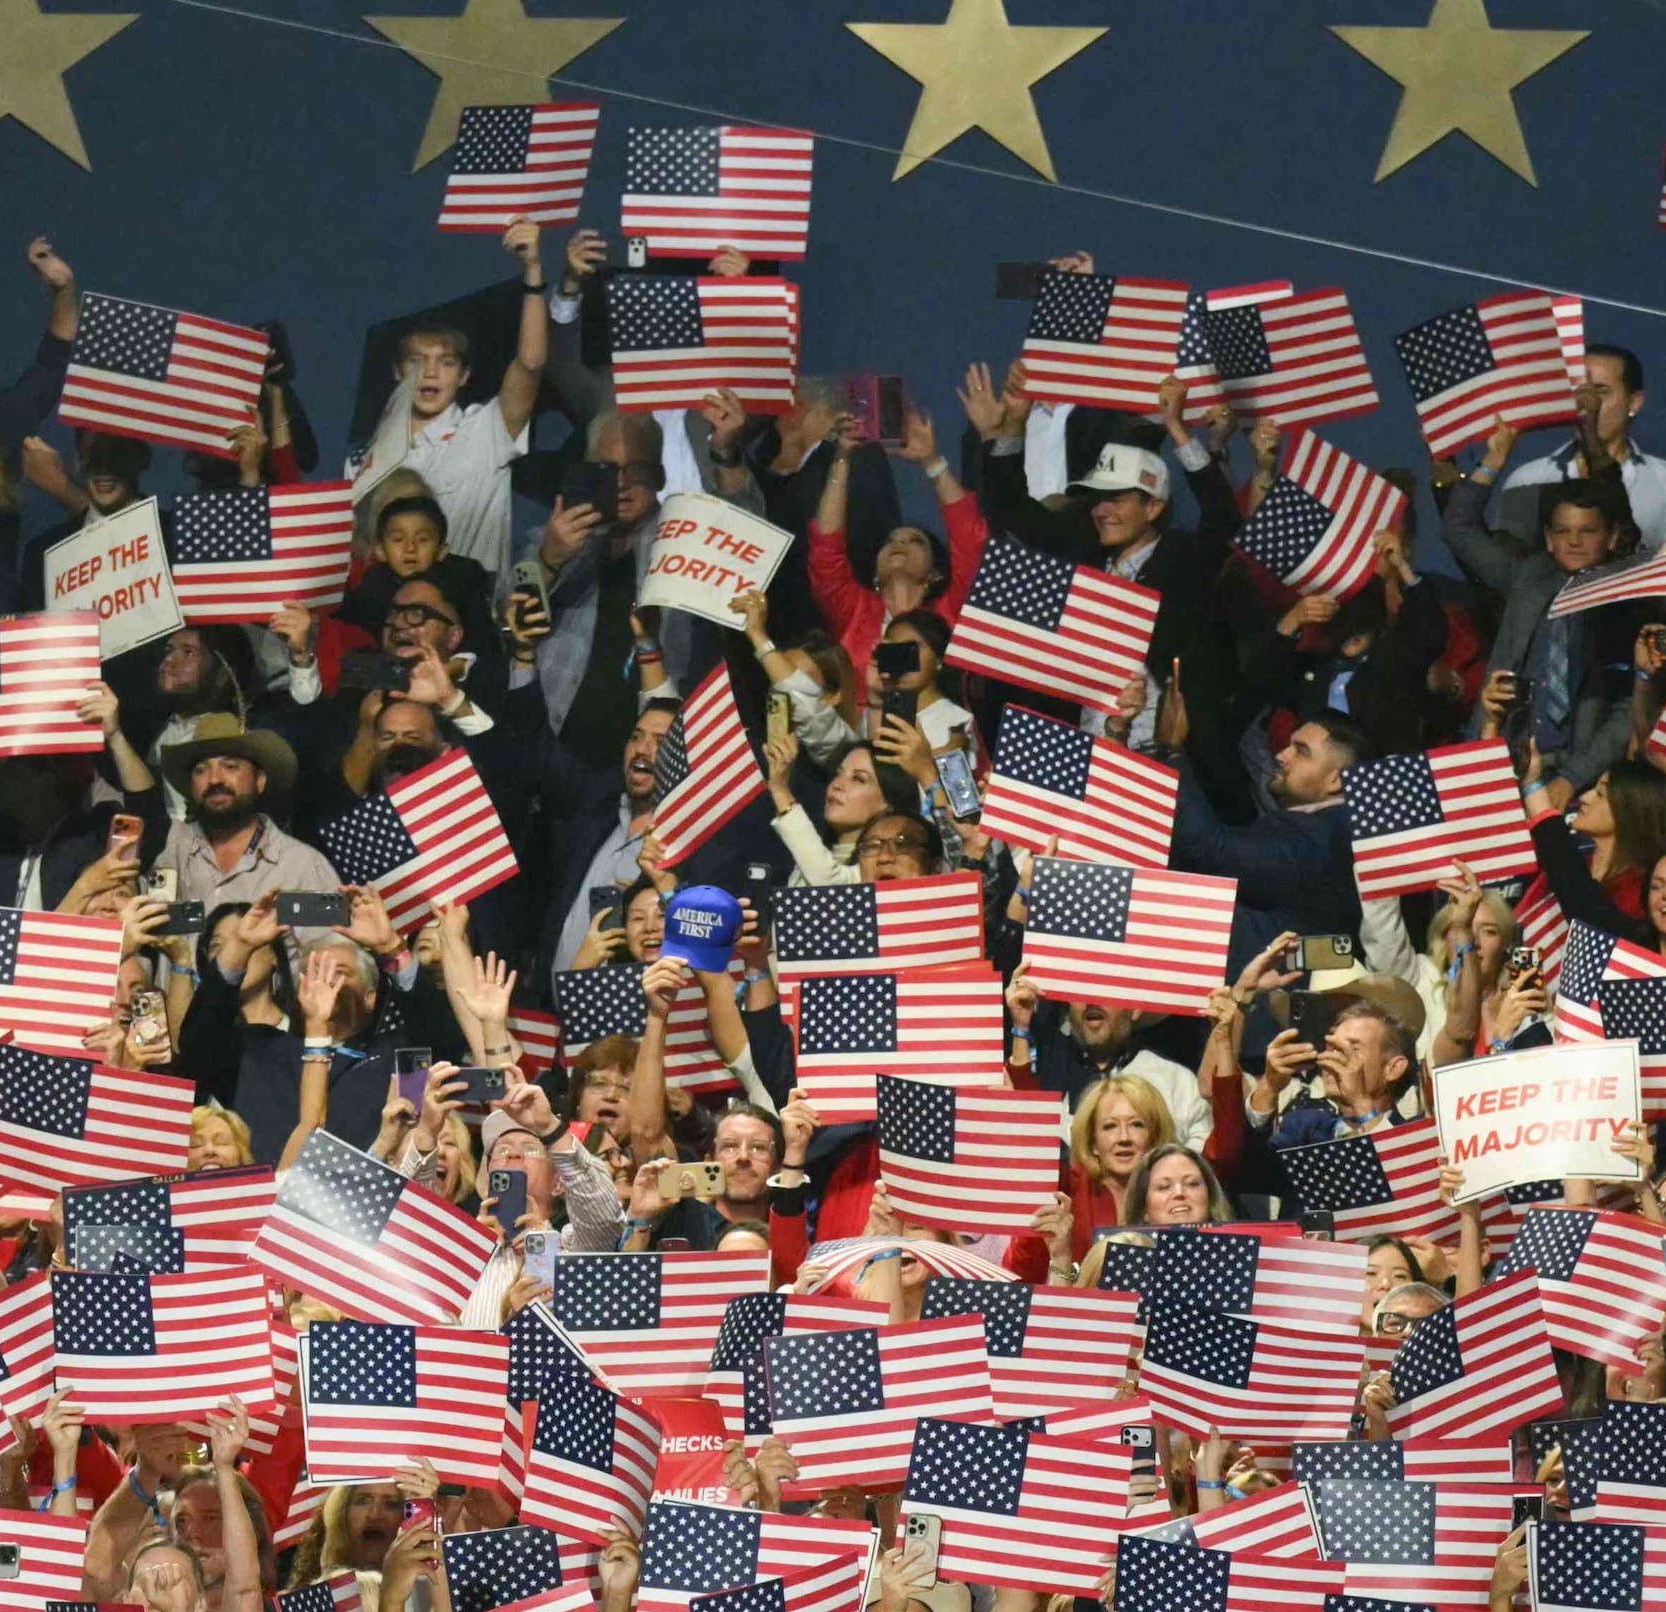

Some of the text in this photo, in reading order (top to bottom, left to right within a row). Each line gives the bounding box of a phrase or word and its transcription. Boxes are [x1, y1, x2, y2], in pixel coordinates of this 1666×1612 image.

[655, 518, 765, 565] EEP THE
[54, 534, 150, 600] KEEP THE
[649, 554, 755, 597] JORITY
[92, 572, 163, 621] ORITY
[672, 906, 724, 927] AMERICA
[679, 921, 714, 939] FIRST
[1454, 1076, 1620, 1121] KEEP THE
[1453, 1116, 1630, 1166] MAJORITY
[152, 1174, 186, 1185] DALLAS
[660, 1435, 723, 1454] HECKS
[651, 1486, 728, 1504] AMILIES
